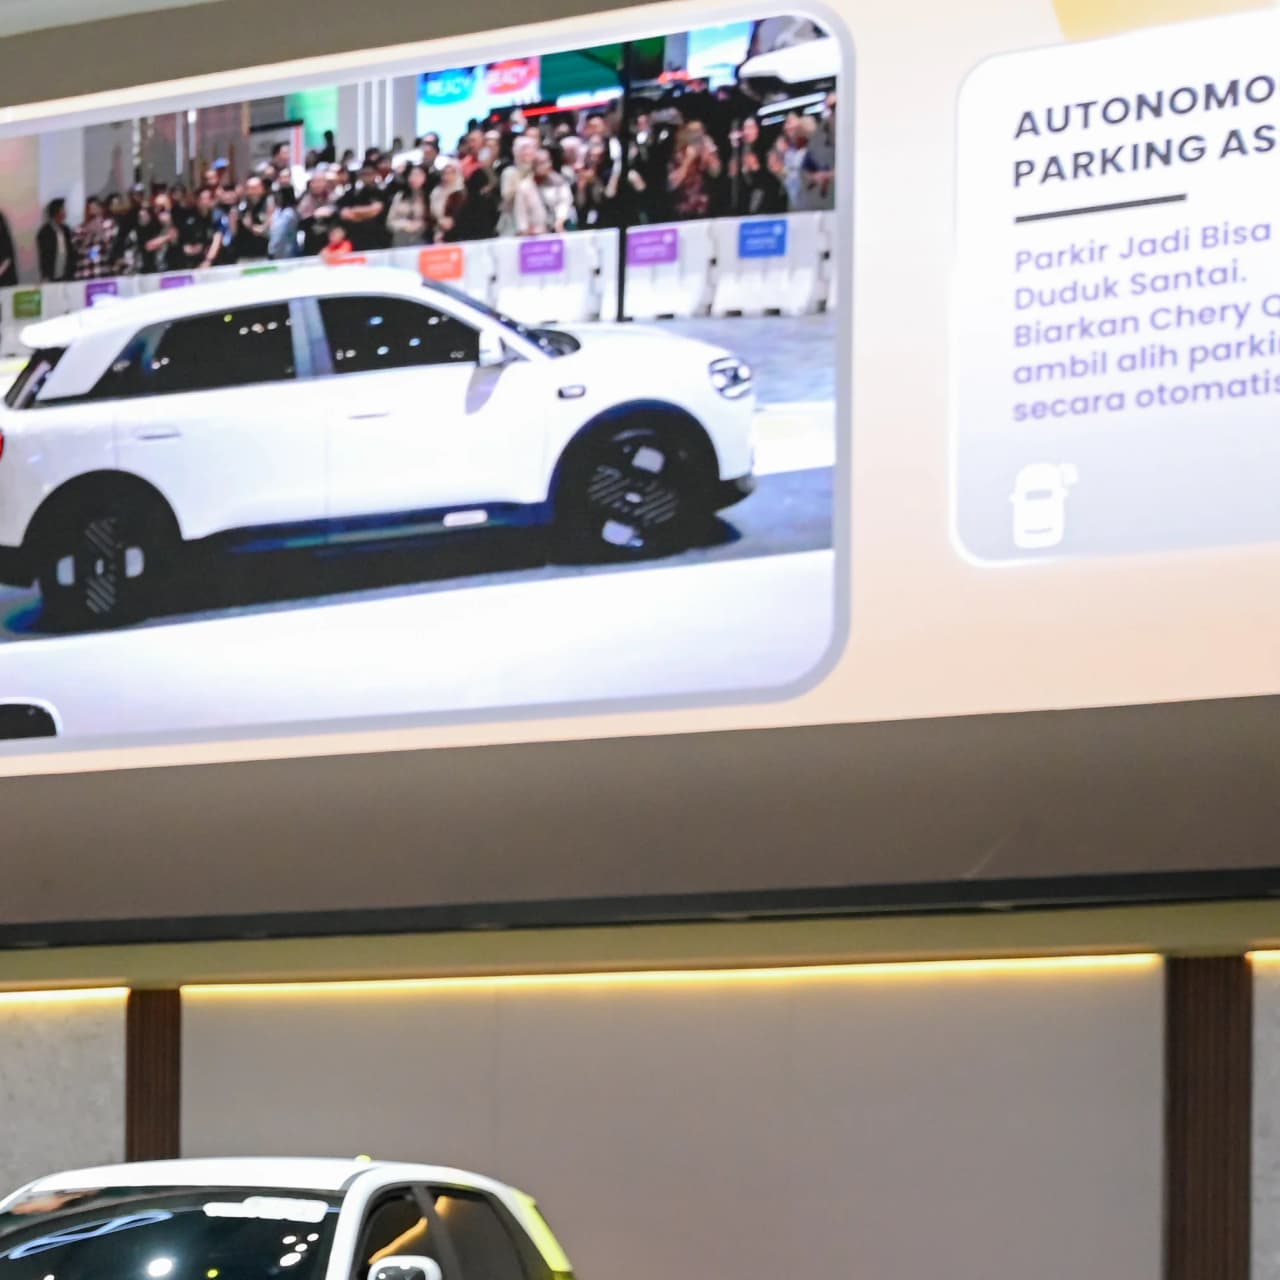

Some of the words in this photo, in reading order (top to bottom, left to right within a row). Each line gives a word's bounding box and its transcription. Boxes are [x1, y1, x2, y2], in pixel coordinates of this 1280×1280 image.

[1013, 75, 1277, 140] AUTONOMO
[1013, 135, 1207, 188] PARKING
[1218, 124, 1277, 159] AS
[1015, 240, 1108, 272] Parkir
[1119, 229, 1190, 259] Jadi
[1201, 221, 1272, 249] Bisa
[1015, 272, 1119, 310] Duduk
[1130, 258, 1247, 295] Santai.
[1014, 316, 1140, 347] Biarkan
[1149, 301, 1251, 331] Chery
[1013, 351, 1107, 385] ambil
[1117, 344, 1178, 373] alih
[1189, 330, 1280, 373] parki
[1013, 389, 1126, 421] secara
